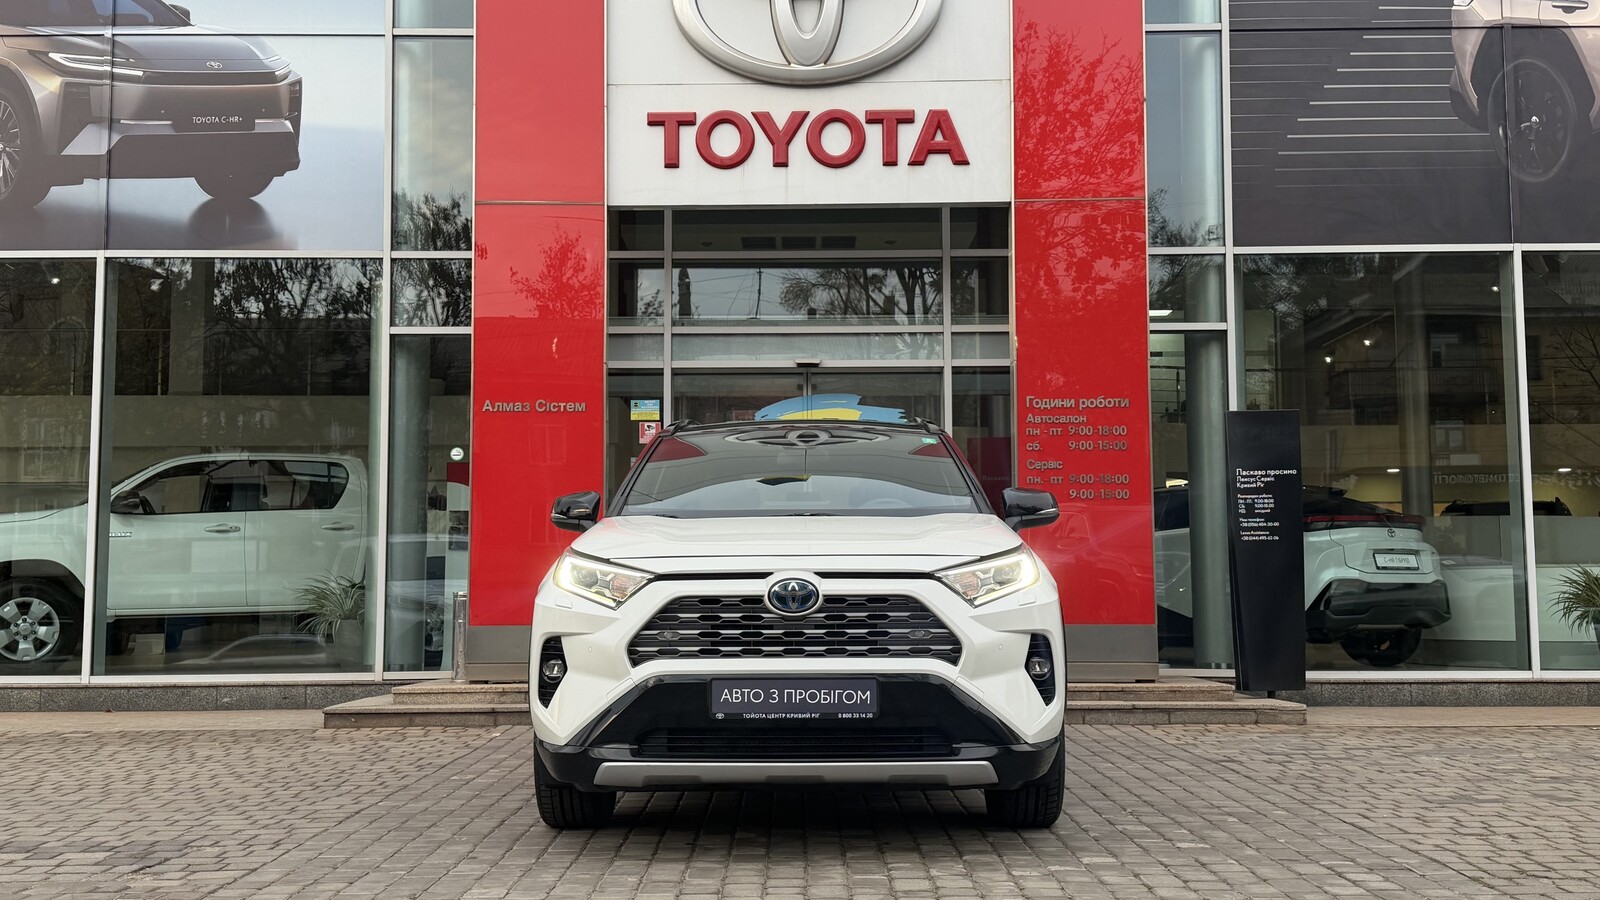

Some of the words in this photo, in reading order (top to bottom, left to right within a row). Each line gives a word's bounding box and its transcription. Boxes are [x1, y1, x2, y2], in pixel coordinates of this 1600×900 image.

[192, 116, 220, 124] TOYOTA
[647, 109, 970, 169] TOYOTA
[481, 399, 531, 412] Алмаз
[535, 399, 587, 412] Сістем
[1025, 396, 1076, 410] Години
[1079, 396, 1130, 411] роботи
[1025, 413, 1087, 423] Автосалон
[1026, 459, 1064, 471] Сервіс
[720, 688, 764, 703] АВТО
[784, 689, 871, 704] ПРОБІГОМ
[767, 712, 785, 720] ЦЕНТР
[786, 711, 811, 719] КРИВИЙ
